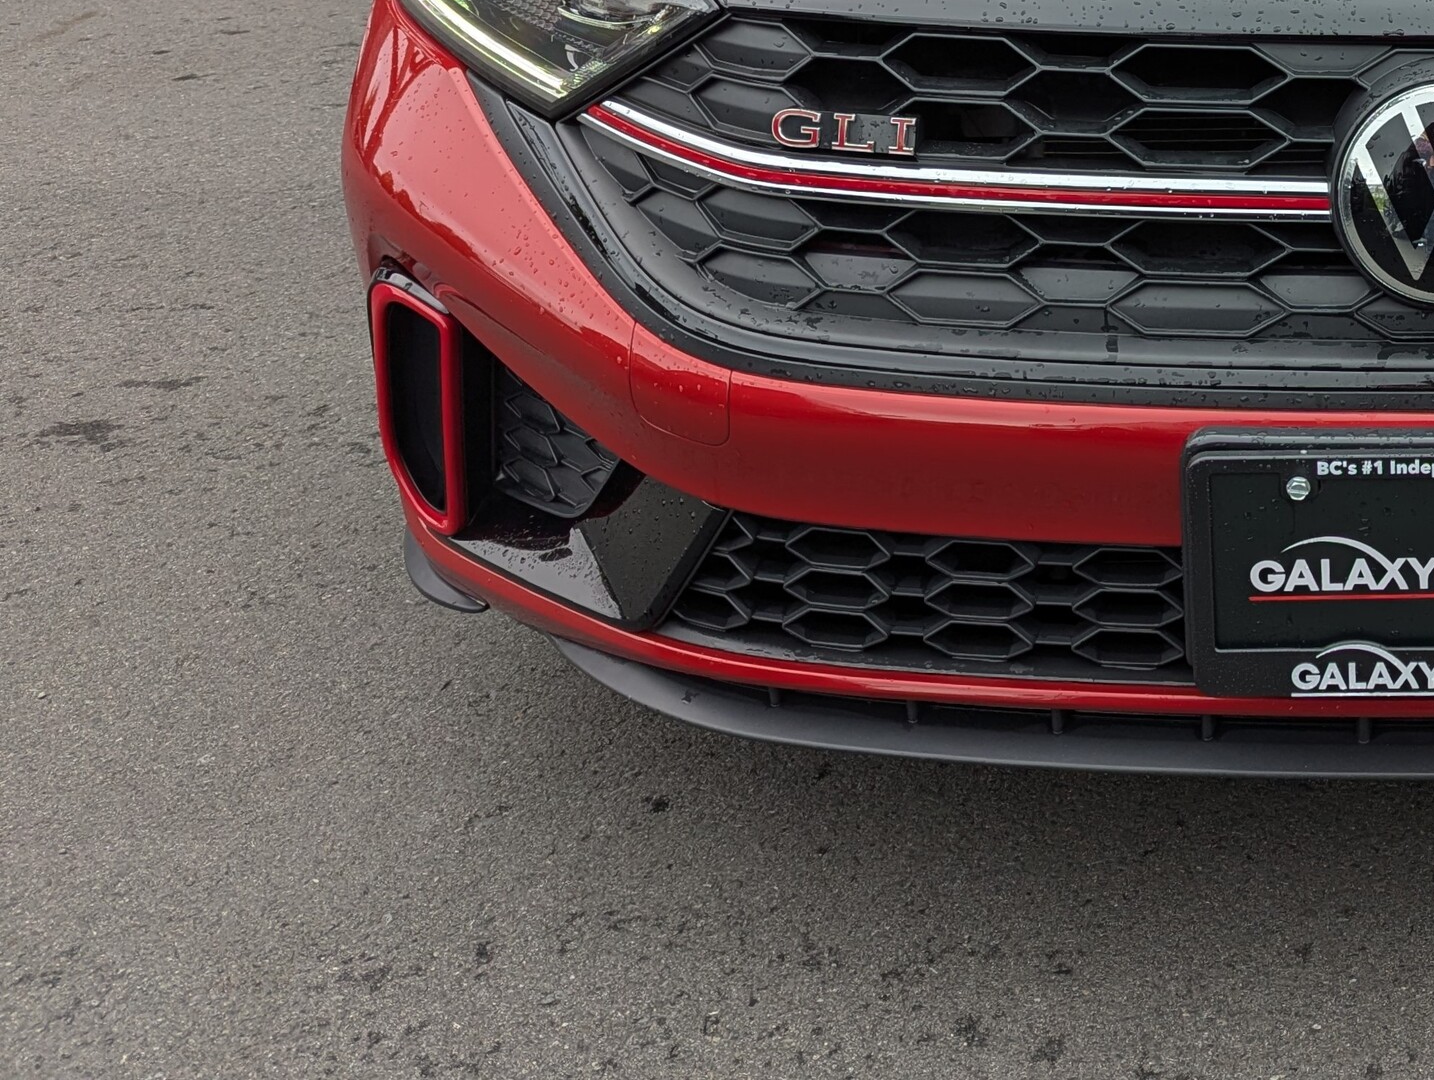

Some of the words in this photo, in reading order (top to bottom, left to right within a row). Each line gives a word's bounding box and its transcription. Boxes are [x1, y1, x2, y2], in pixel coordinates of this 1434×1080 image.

[771, 108, 917, 156] GLI
[1316, 460, 1357, 476] BC's
[1361, 460, 1383, 475] #1
